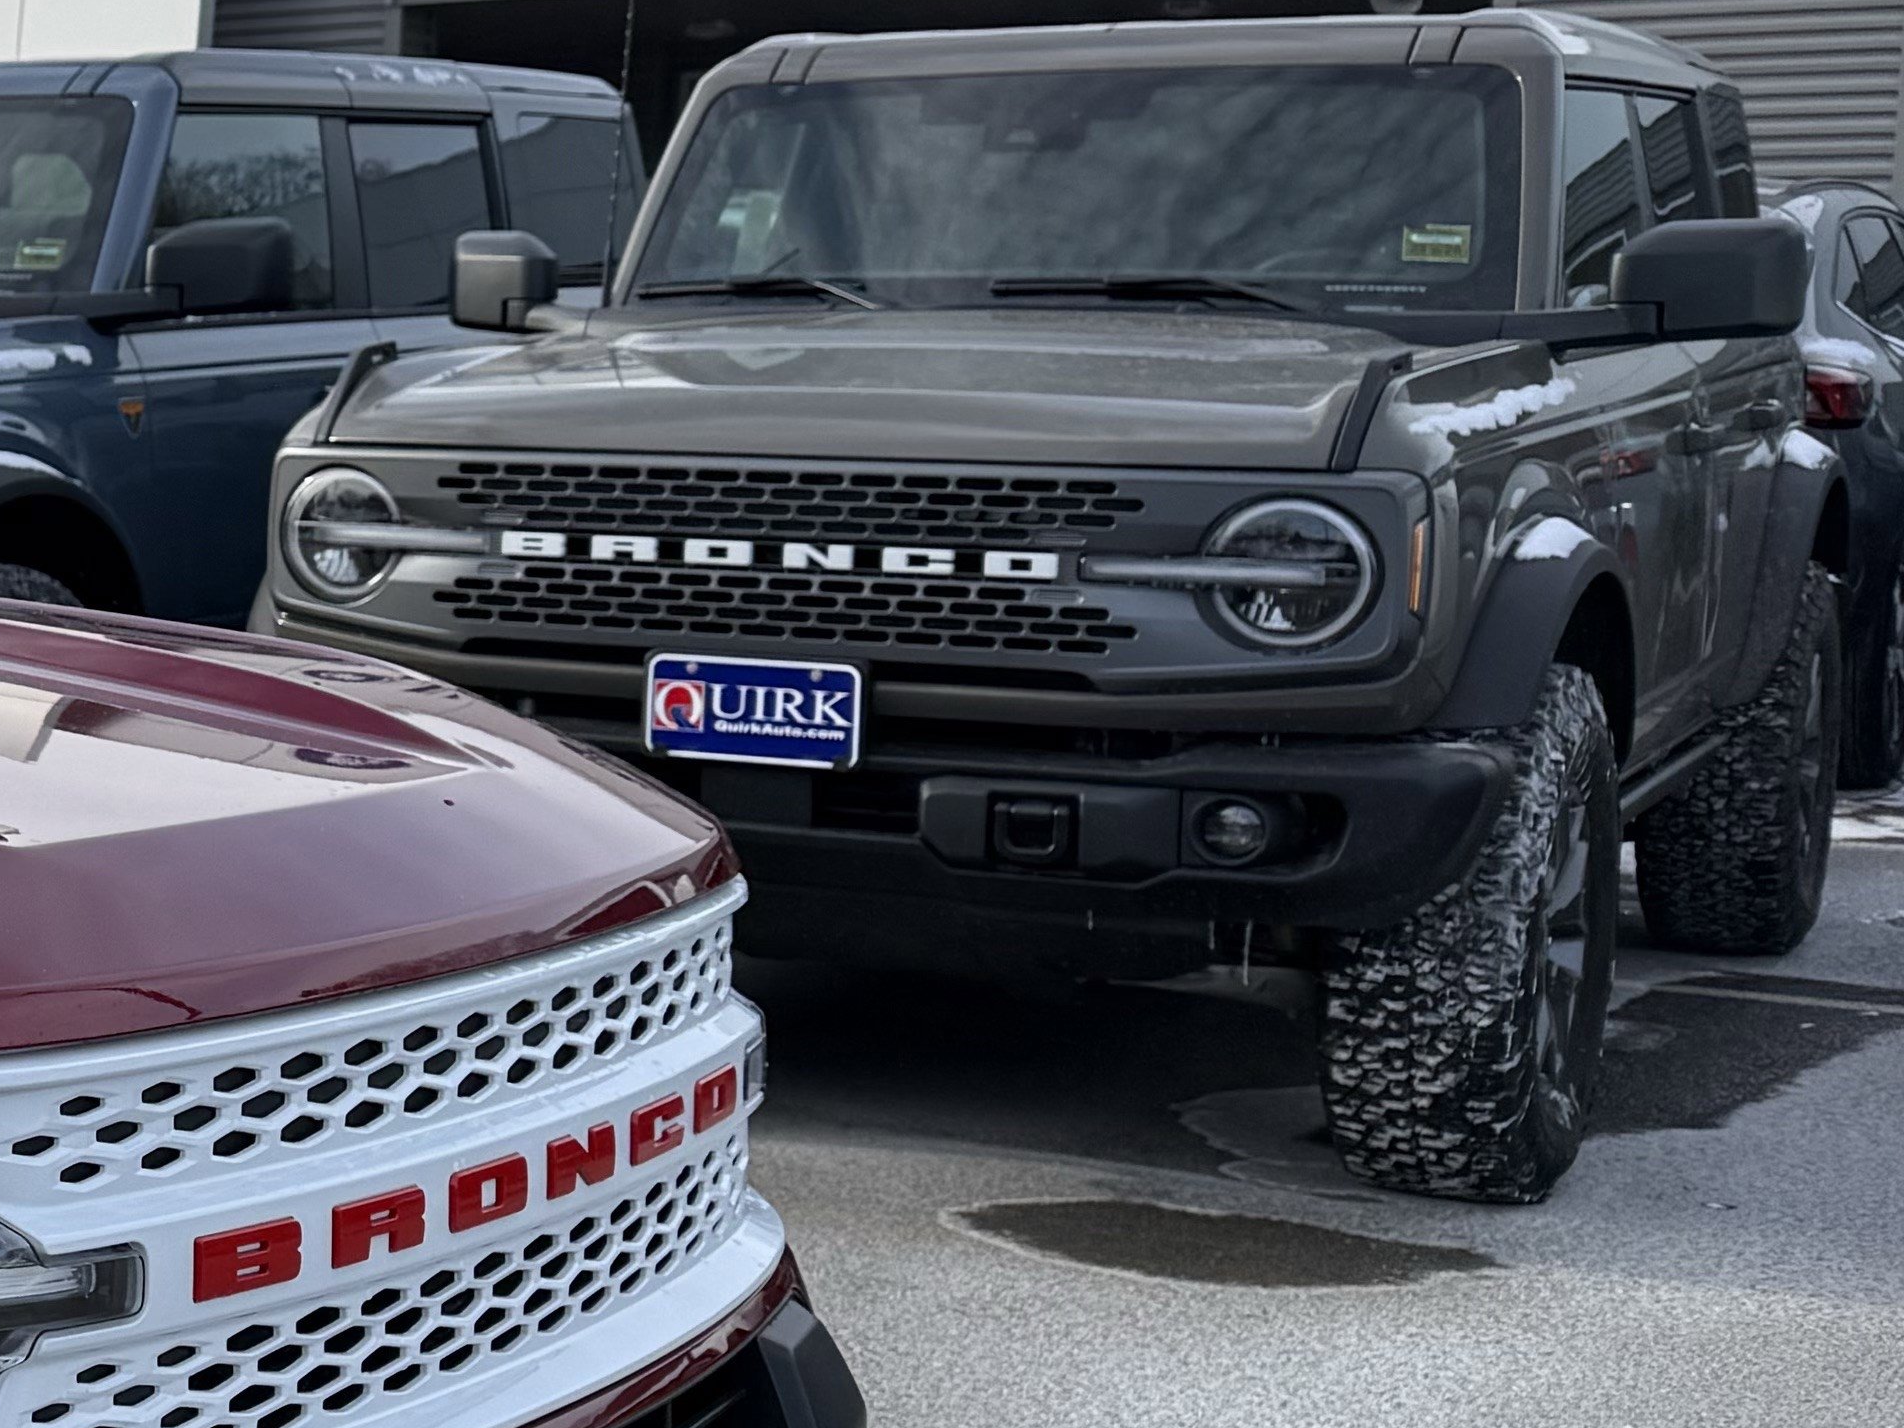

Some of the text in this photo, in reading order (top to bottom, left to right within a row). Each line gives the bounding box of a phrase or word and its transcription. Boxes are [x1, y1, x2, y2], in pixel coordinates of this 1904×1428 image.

[501, 529, 1059, 581] BRONCO
[714, 719, 846, 742] QuirkAuto.com
[192, 1063, 738, 1304] BRONCO
